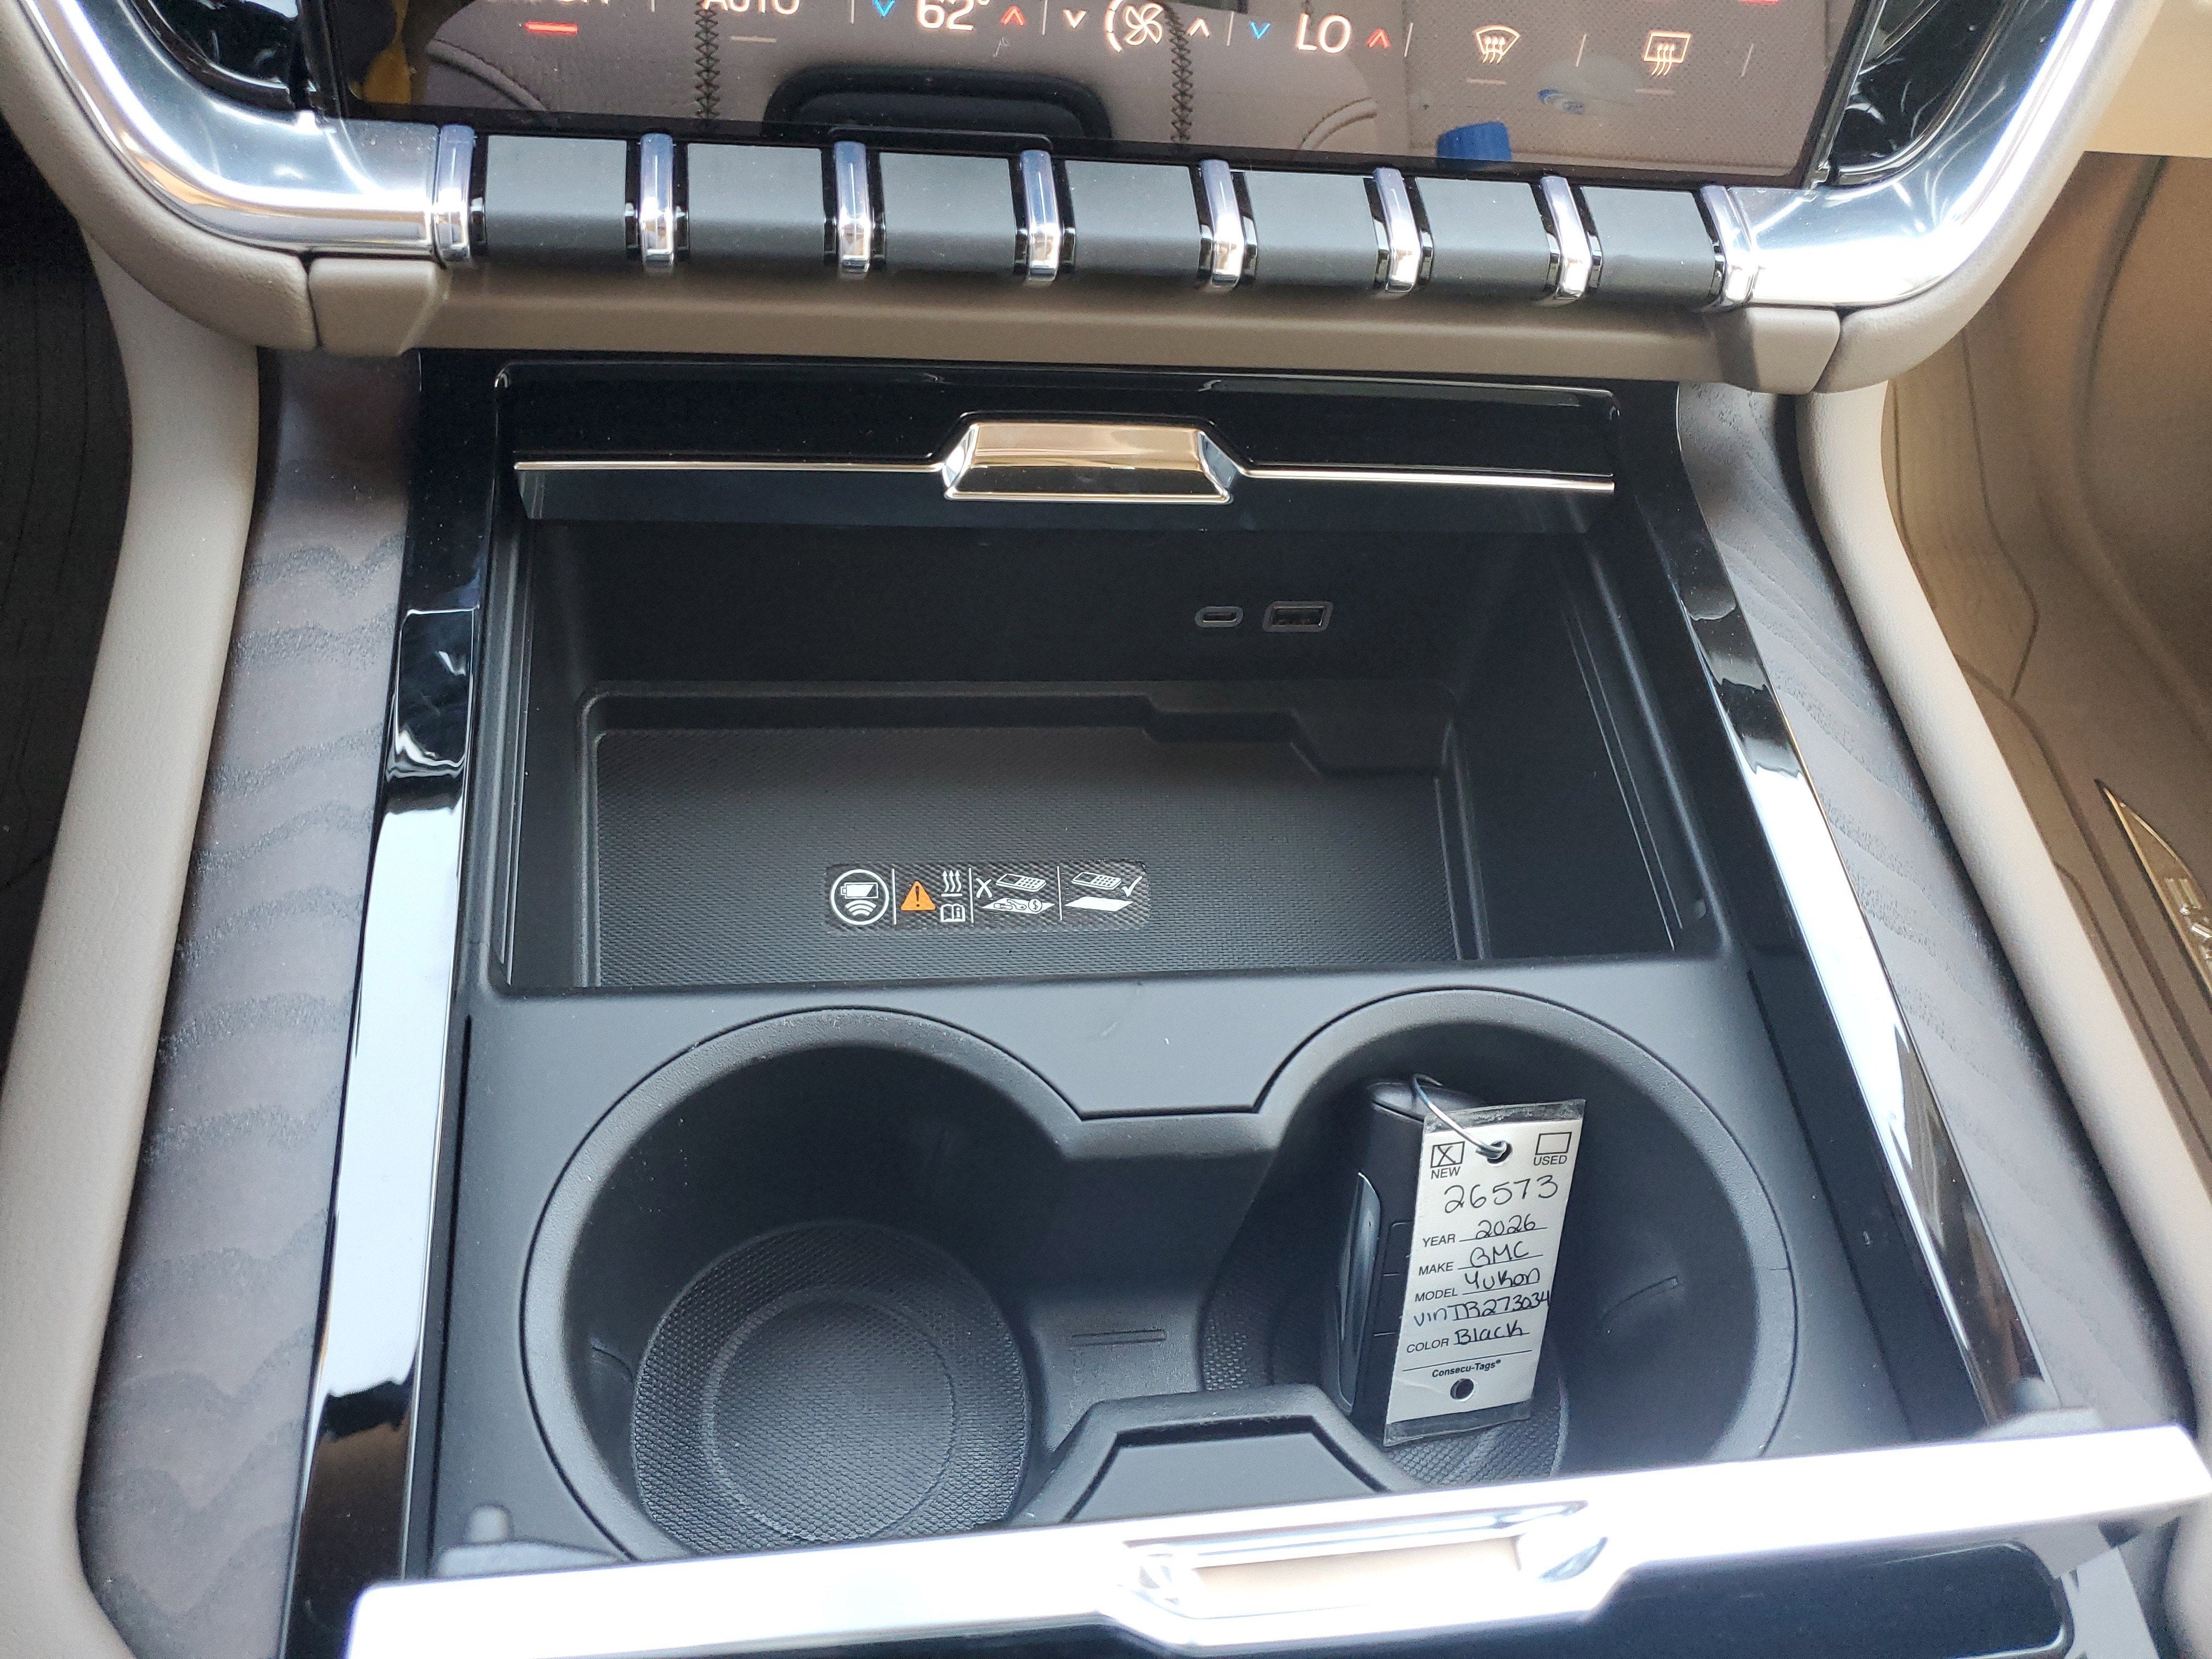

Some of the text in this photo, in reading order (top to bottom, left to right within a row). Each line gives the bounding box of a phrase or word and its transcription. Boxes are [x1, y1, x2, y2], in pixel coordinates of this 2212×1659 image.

[1296, 13, 1352, 54] LO
[1533, 1155, 1568, 1166] USED
[1431, 1166, 1462, 1180] NEW
[1444, 1175, 1559, 1214] 26573
[1423, 1214, 1536, 1248] YEAR 2026
[1418, 1241, 1530, 1276] MAKE GMC
[1414, 1288, 1458, 1302] MODEL
[1406, 1338, 1449, 1353] COLOR
